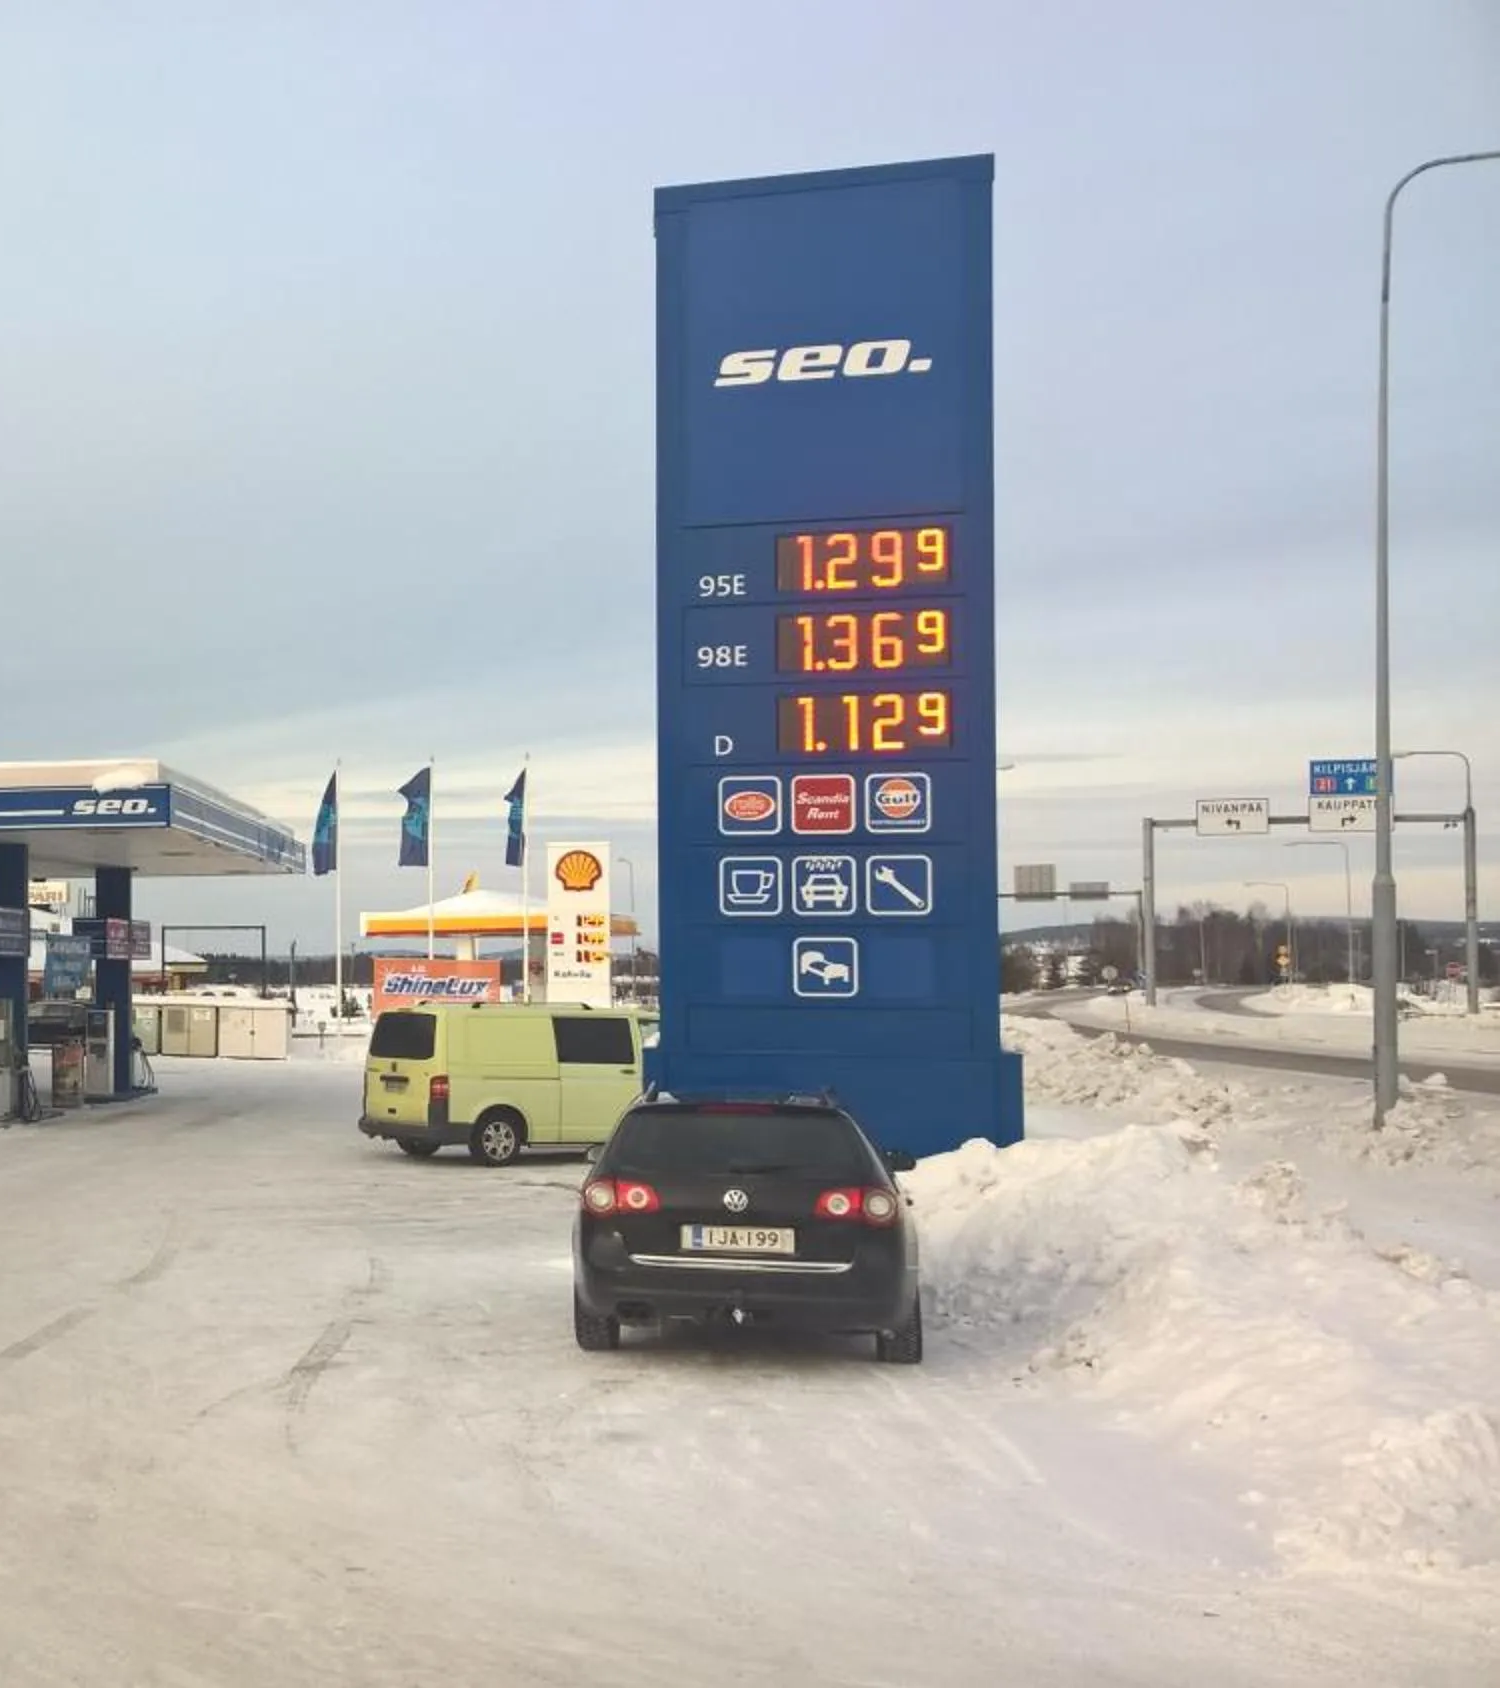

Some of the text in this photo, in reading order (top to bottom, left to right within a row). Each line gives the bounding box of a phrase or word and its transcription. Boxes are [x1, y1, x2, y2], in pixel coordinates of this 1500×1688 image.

[713, 339, 932, 387] seo.
[698, 528, 945, 597] 95E 1.299
[697, 610, 945, 671] 98E 1.369
[714, 691, 947, 756] D 1.129
[796, 791, 849, 806] Scandia
[807, 807, 840, 820] Rent
[877, 793, 918, 805] Gulf
[708, 1226, 780, 1247] IJA-199
